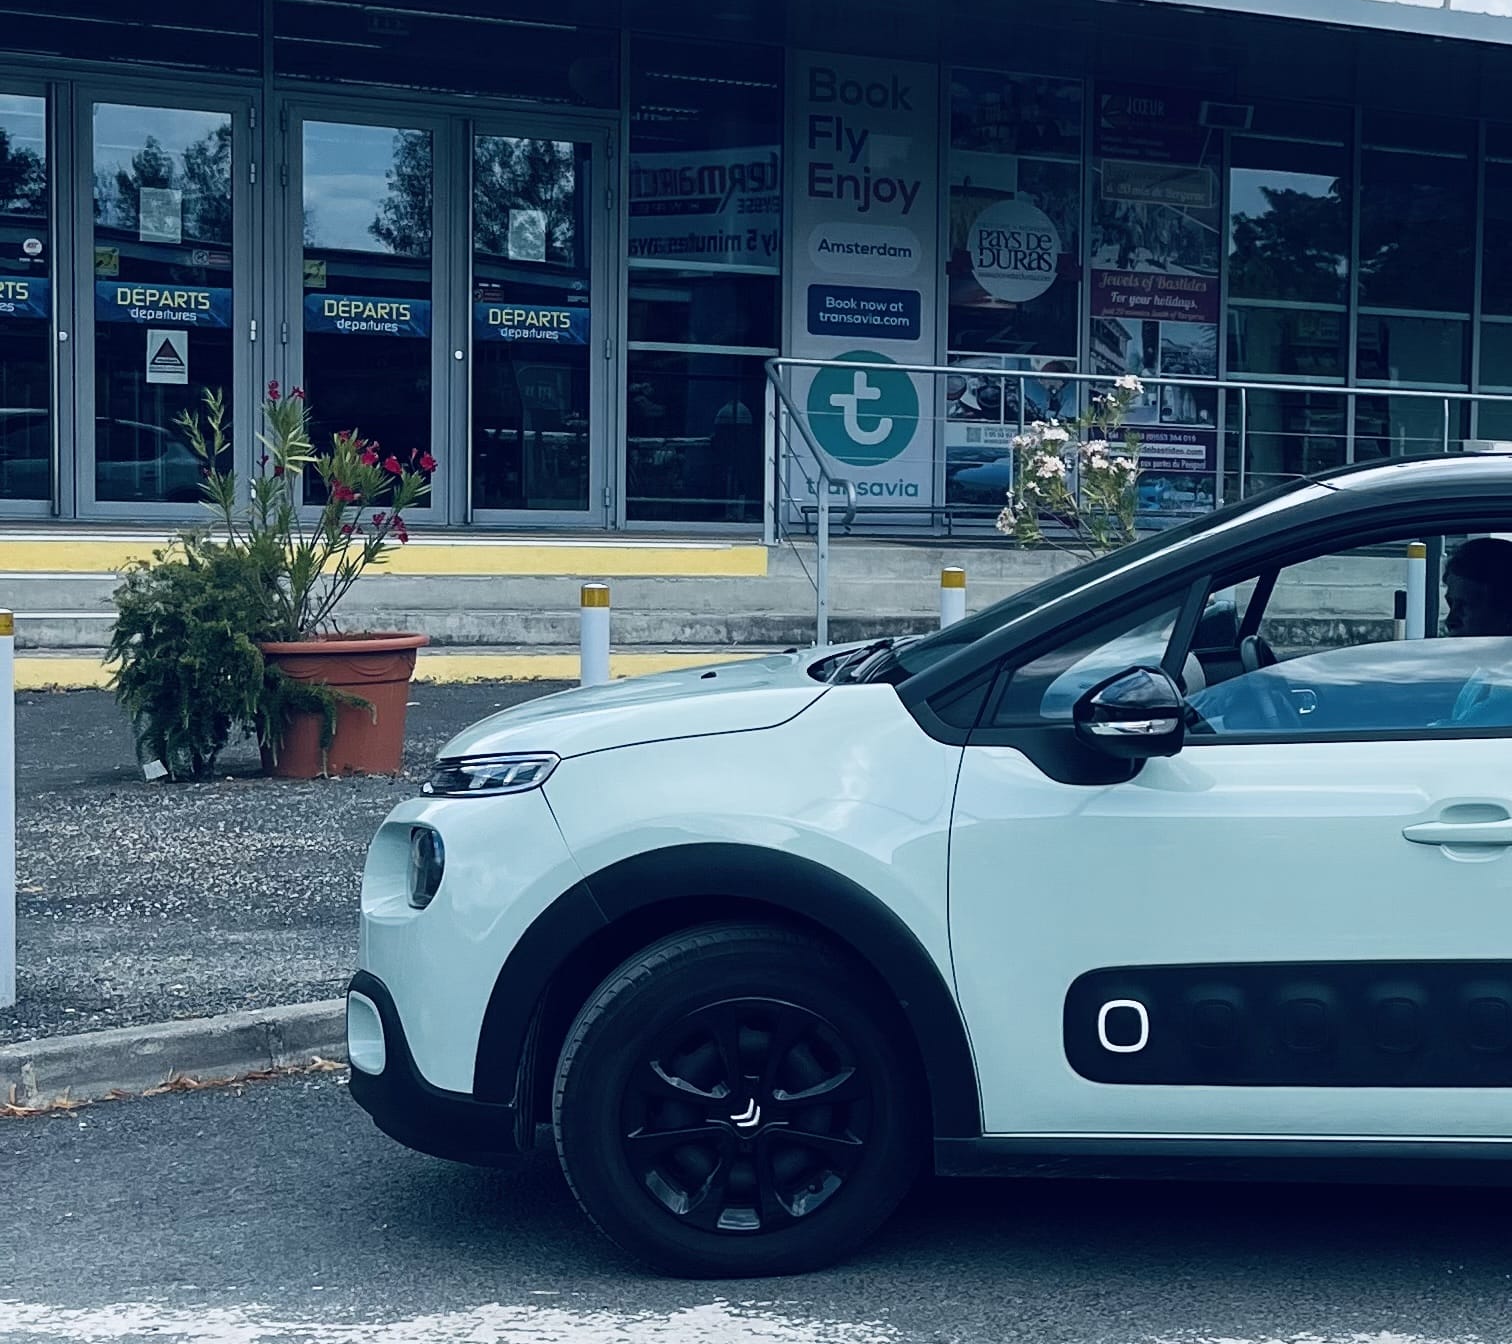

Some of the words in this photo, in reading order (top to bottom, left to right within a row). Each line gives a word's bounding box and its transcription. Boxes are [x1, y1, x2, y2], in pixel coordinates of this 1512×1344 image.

[808, 66, 912, 111] Book
[808, 114, 869, 163] Fly
[808, 162, 920, 215] Enjoy
[818, 239, 912, 258] Amsterdam
[117, 286, 210, 310] DÉPARTS
[825, 296, 857, 310] Book
[860, 301, 887, 312] now
[889, 301, 904, 313] at
[1111, 291, 1128, 303] For
[1129, 295, 1152, 307] your
[130, 308, 197, 322] departures
[324, 297, 411, 321] DÉPARTS
[488, 306, 571, 328] DÉPARTS
[336, 318, 399, 333] departures
[819, 311, 910, 327] transavia.com
[500, 327, 559, 340] departures
